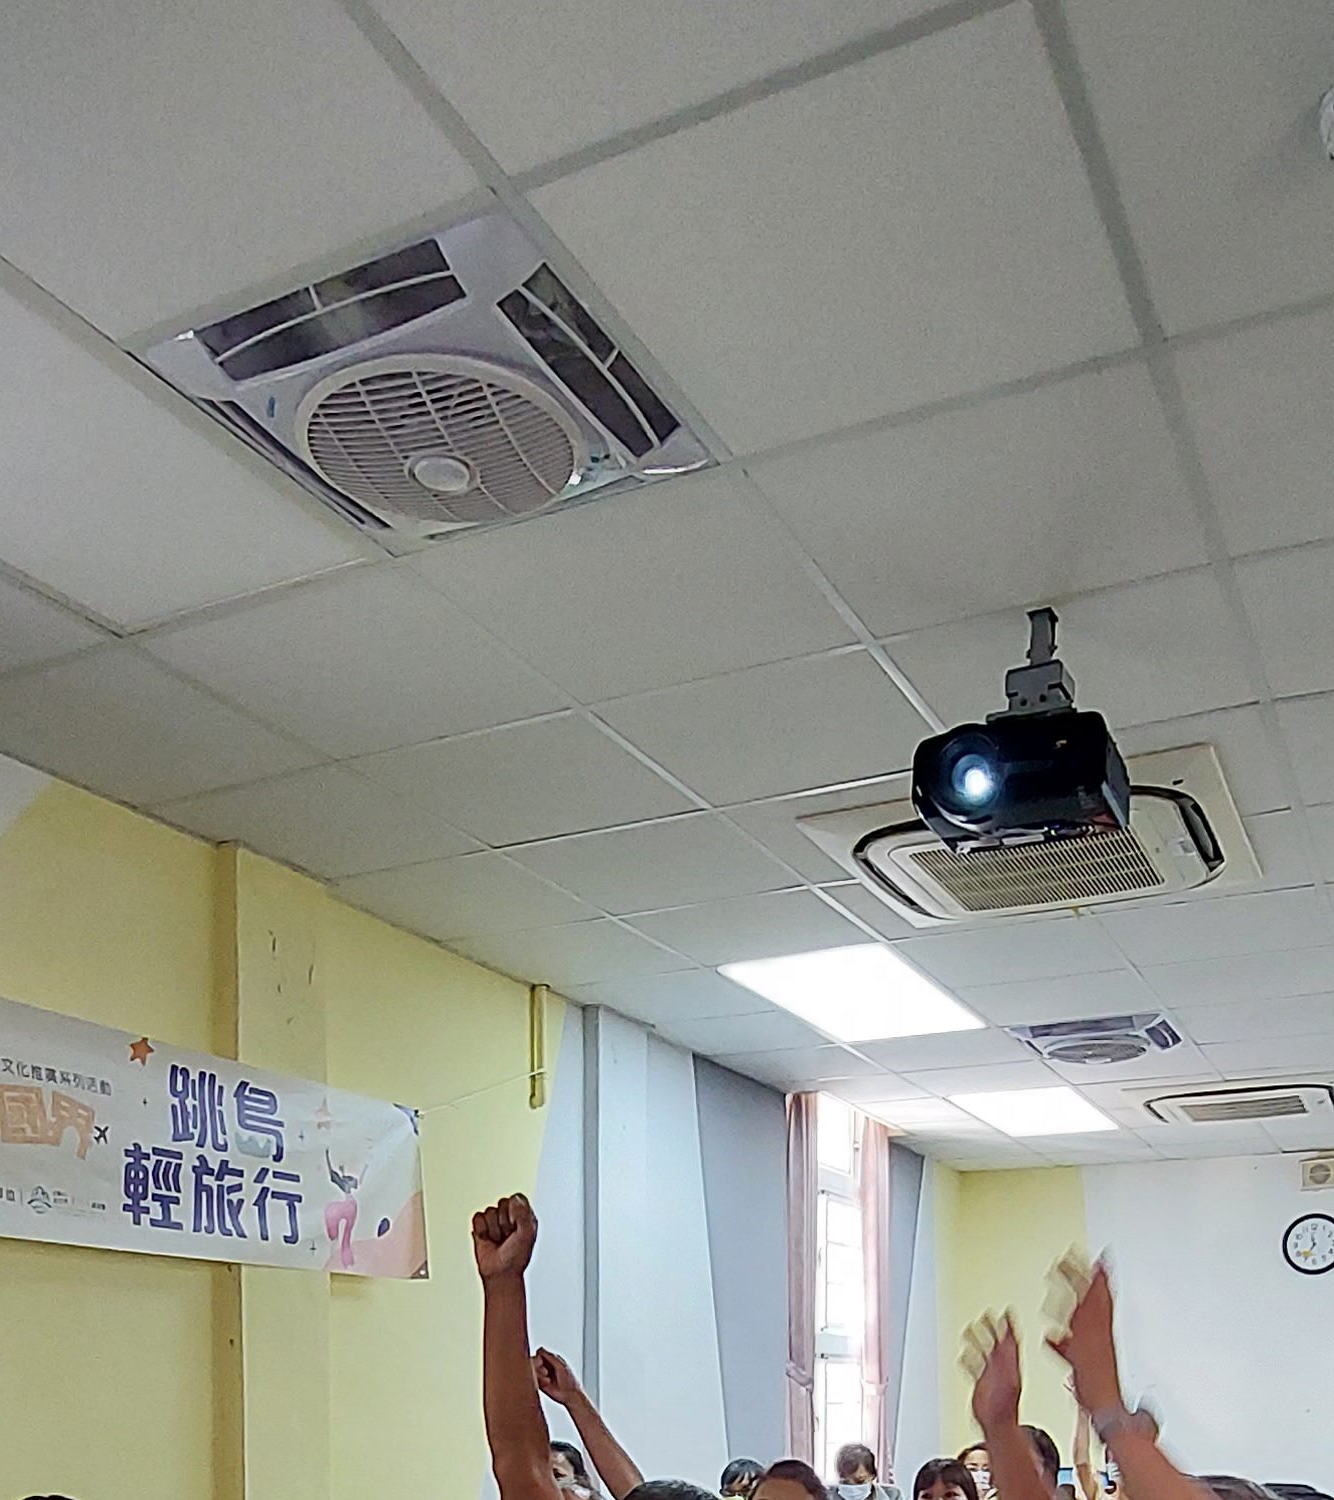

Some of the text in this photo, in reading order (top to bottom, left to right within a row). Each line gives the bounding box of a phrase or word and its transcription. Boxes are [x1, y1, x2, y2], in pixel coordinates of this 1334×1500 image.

[169, 1064, 285, 1163] 跳島
[122, 1142, 303, 1245] 輕旅行
